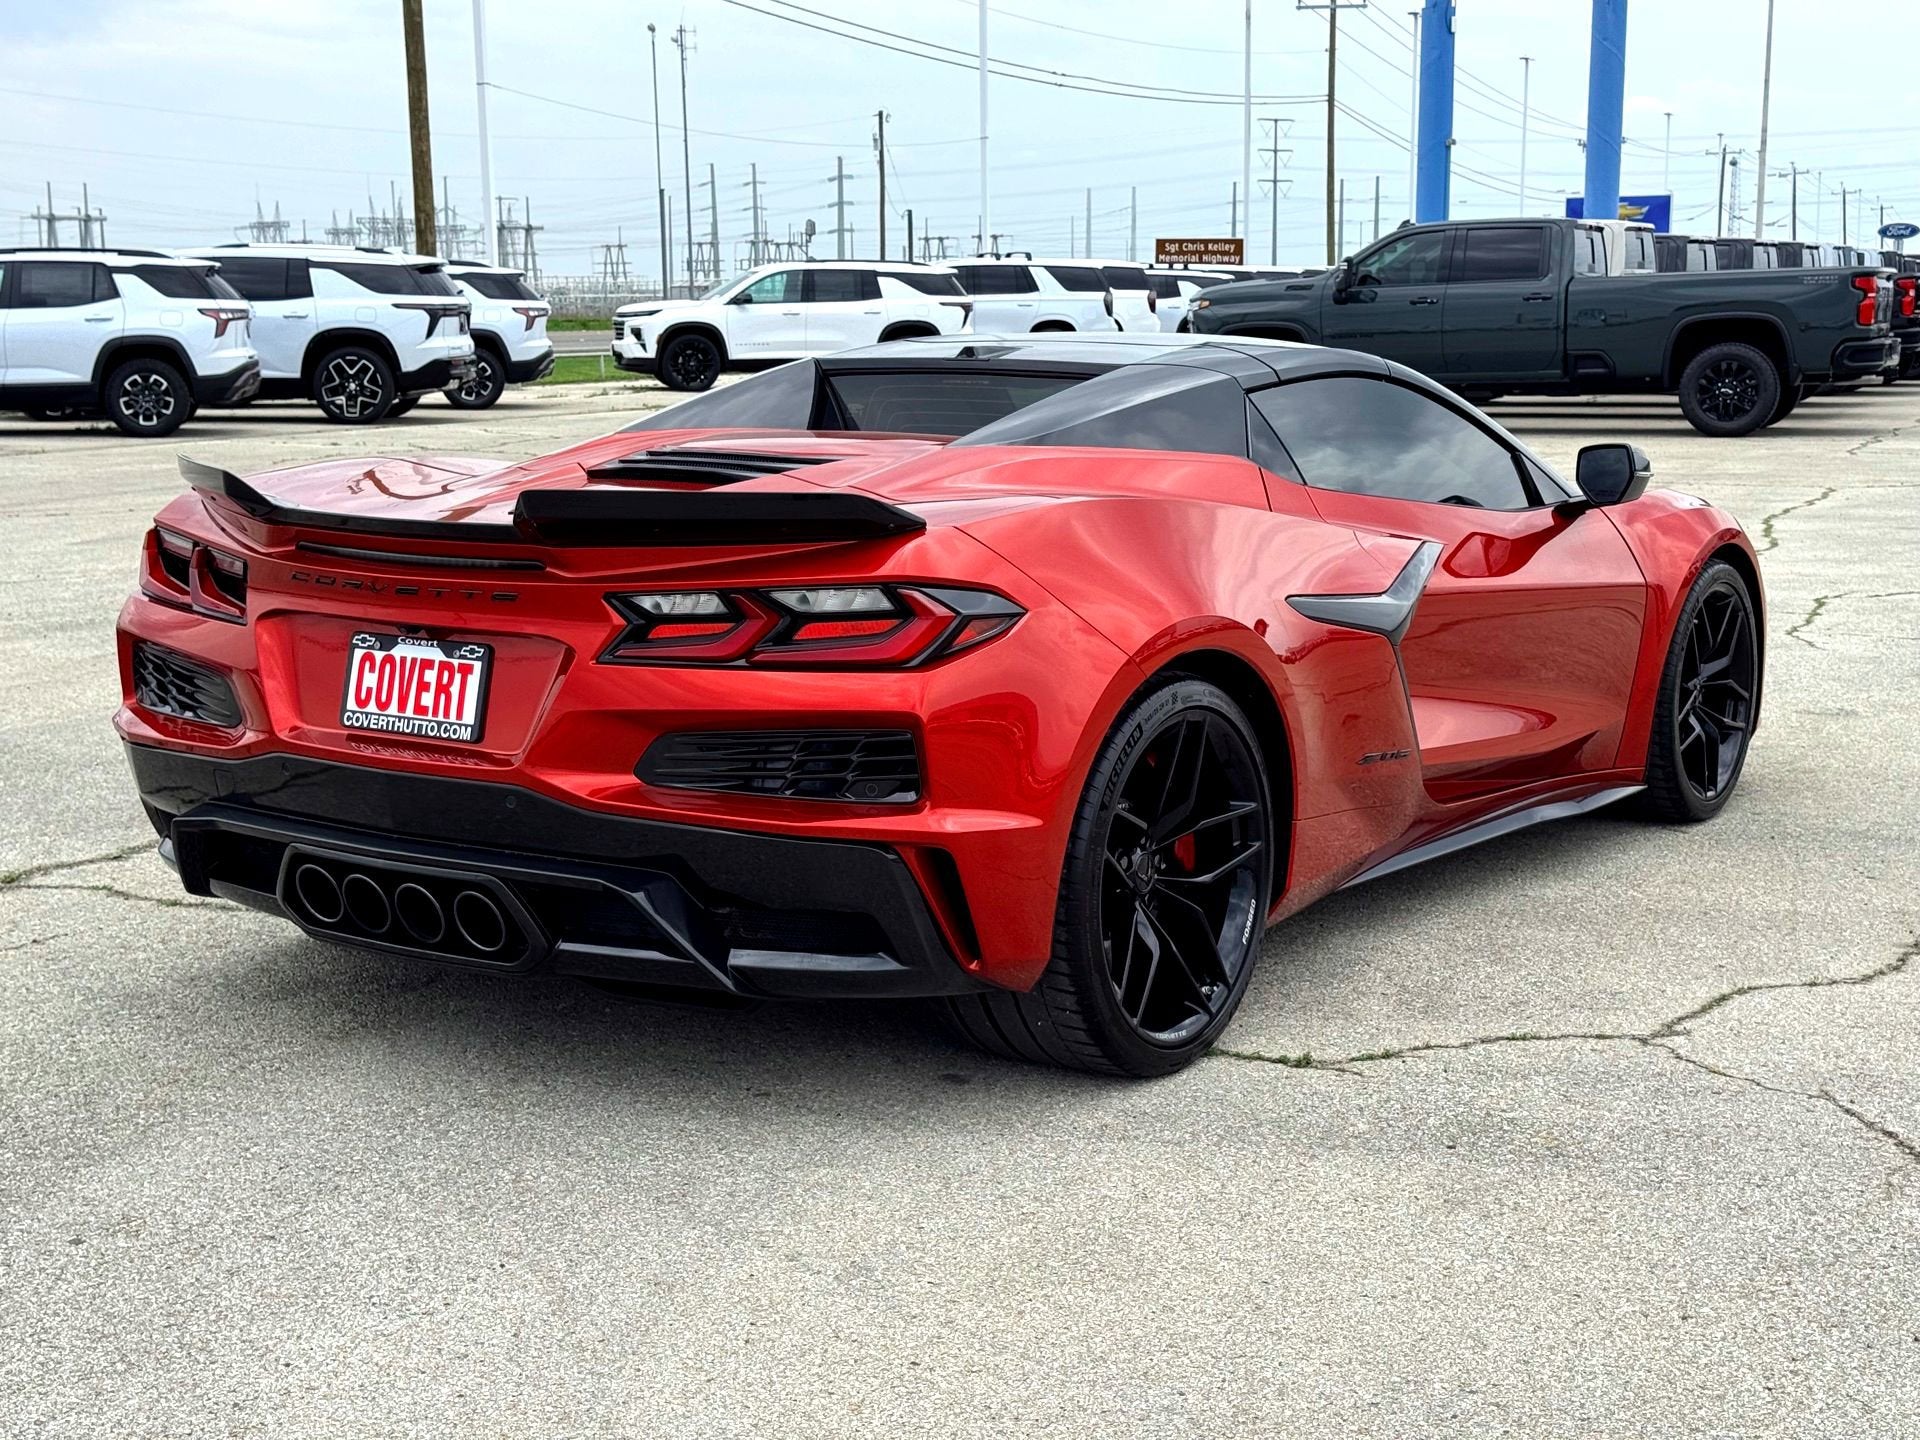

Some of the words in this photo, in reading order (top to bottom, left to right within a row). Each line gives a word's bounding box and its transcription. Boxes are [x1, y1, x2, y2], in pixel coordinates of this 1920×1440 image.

[1158, 253, 1200, 263] Memorial
[1202, 254, 1241, 264] Highway
[1164, 242, 1179, 253] Sgt
[1182, 242, 1205, 252] Chris
[1207, 242, 1236, 253] Kelley
[291, 571, 519, 601] CORVETTE
[397, 636, 438, 648] Covert
[354, 651, 474, 722] COVERT
[343, 711, 472, 741] COVERTHUTTO.COM
[1102, 725, 1144, 809] MICHELIN
[1242, 898, 1256, 945] FORGED
